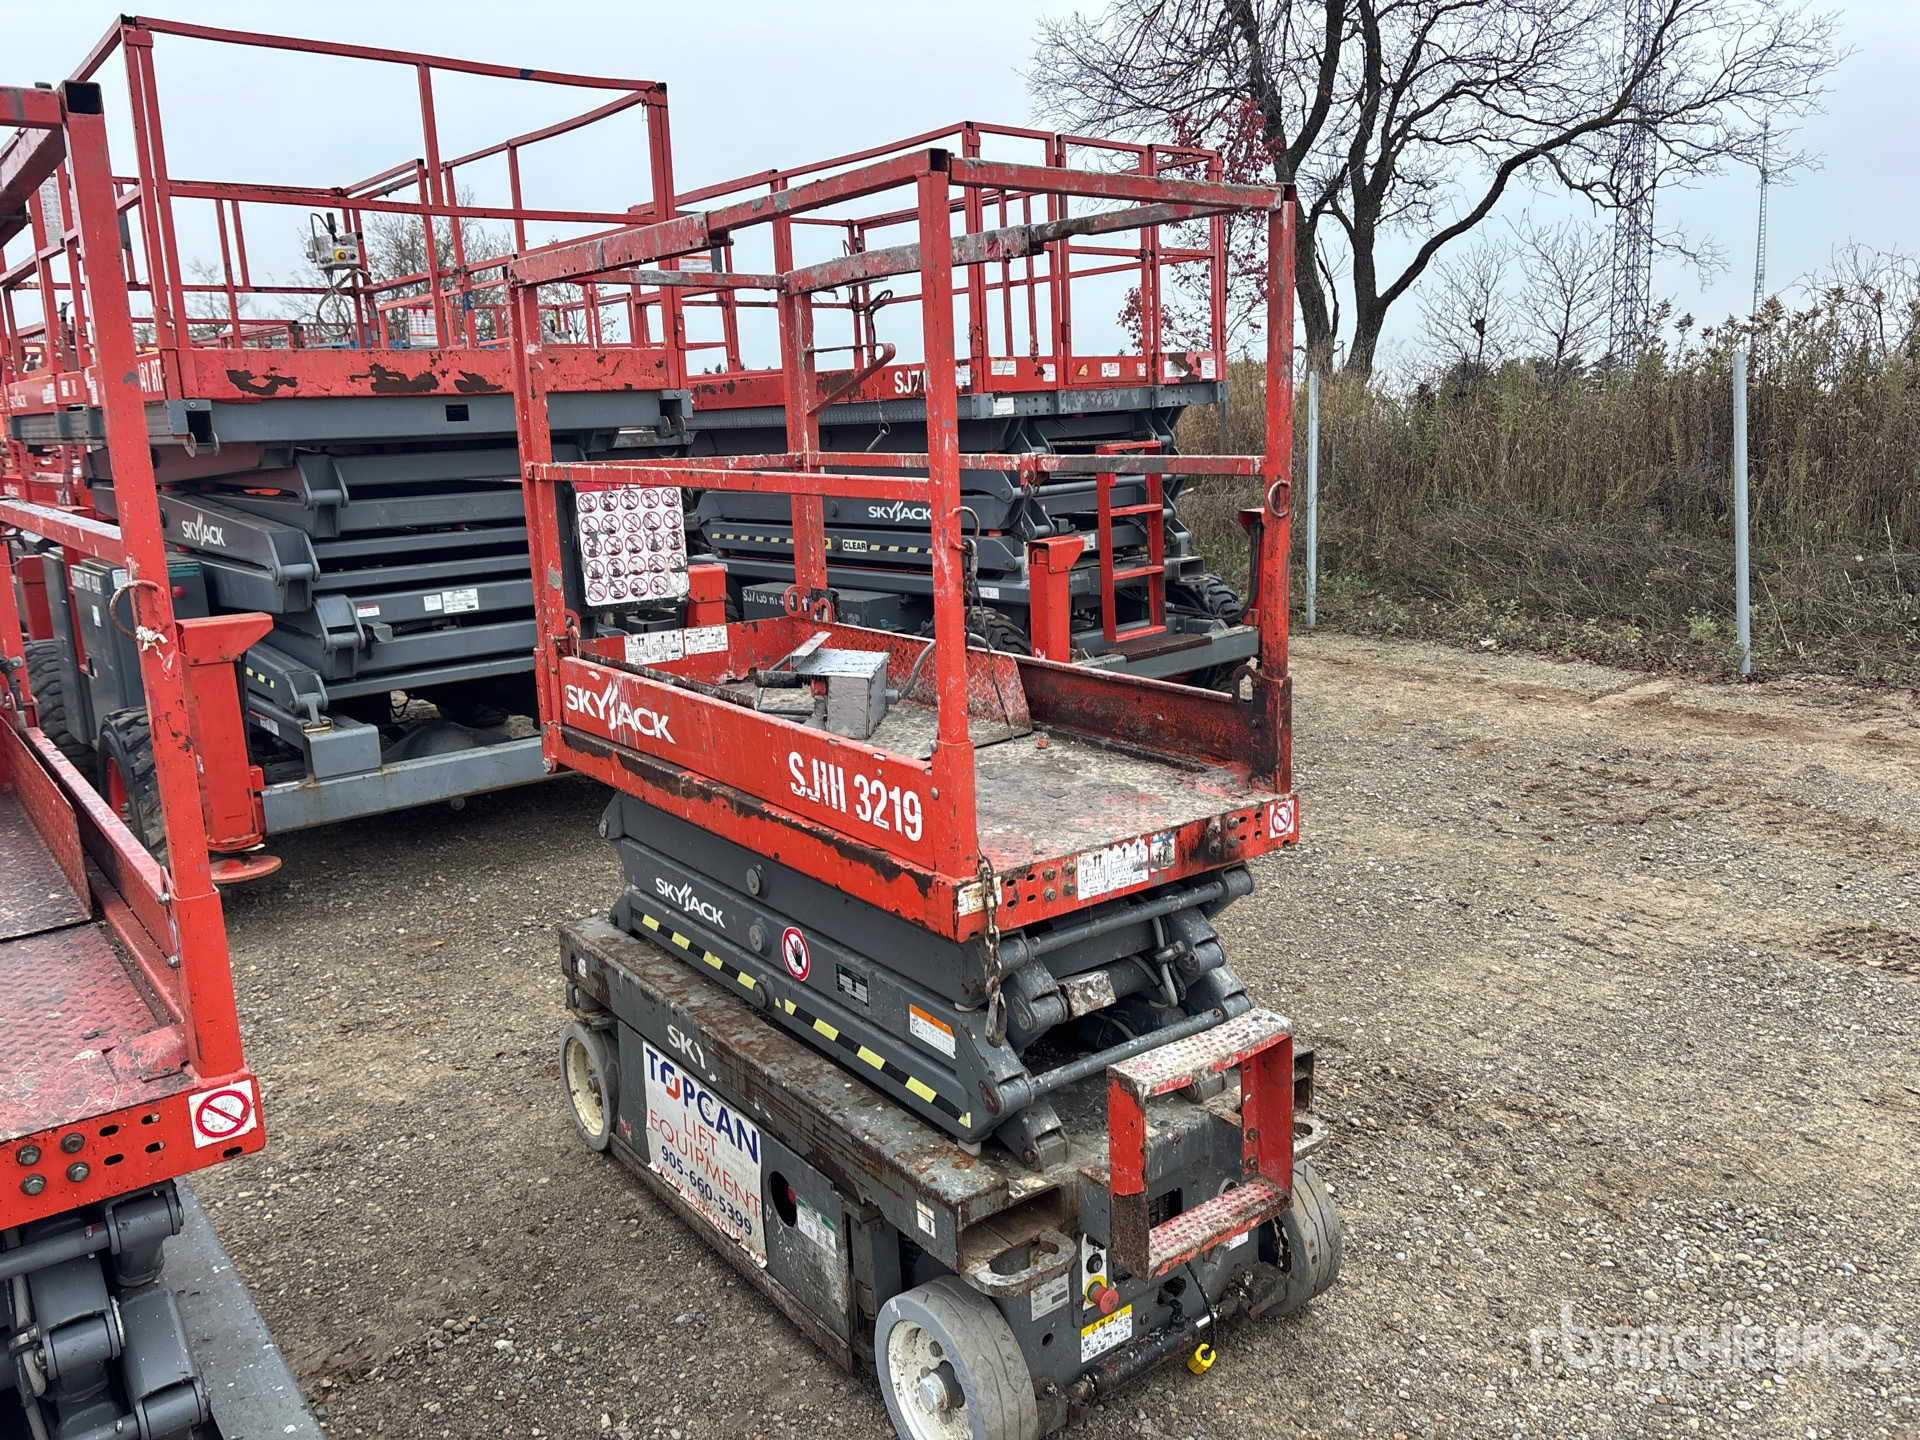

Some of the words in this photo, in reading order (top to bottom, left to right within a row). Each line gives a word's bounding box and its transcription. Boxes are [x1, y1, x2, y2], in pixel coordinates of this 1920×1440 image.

[181, 512, 226, 547] SKYJACK
[868, 501, 931, 522] SKYJACK
[843, 540, 867, 551] CLEAR
[565, 681, 675, 744] SKYJACK
[854, 773, 923, 842] 3219
[655, 877, 726, 929] SKYJACK
[645, 1047, 759, 1165] TOPCAN
[683, 1112, 718, 1156] LIFT
[649, 1108, 761, 1218] EQUIPMENT
[661, 1145, 752, 1236] 905-660-5399
